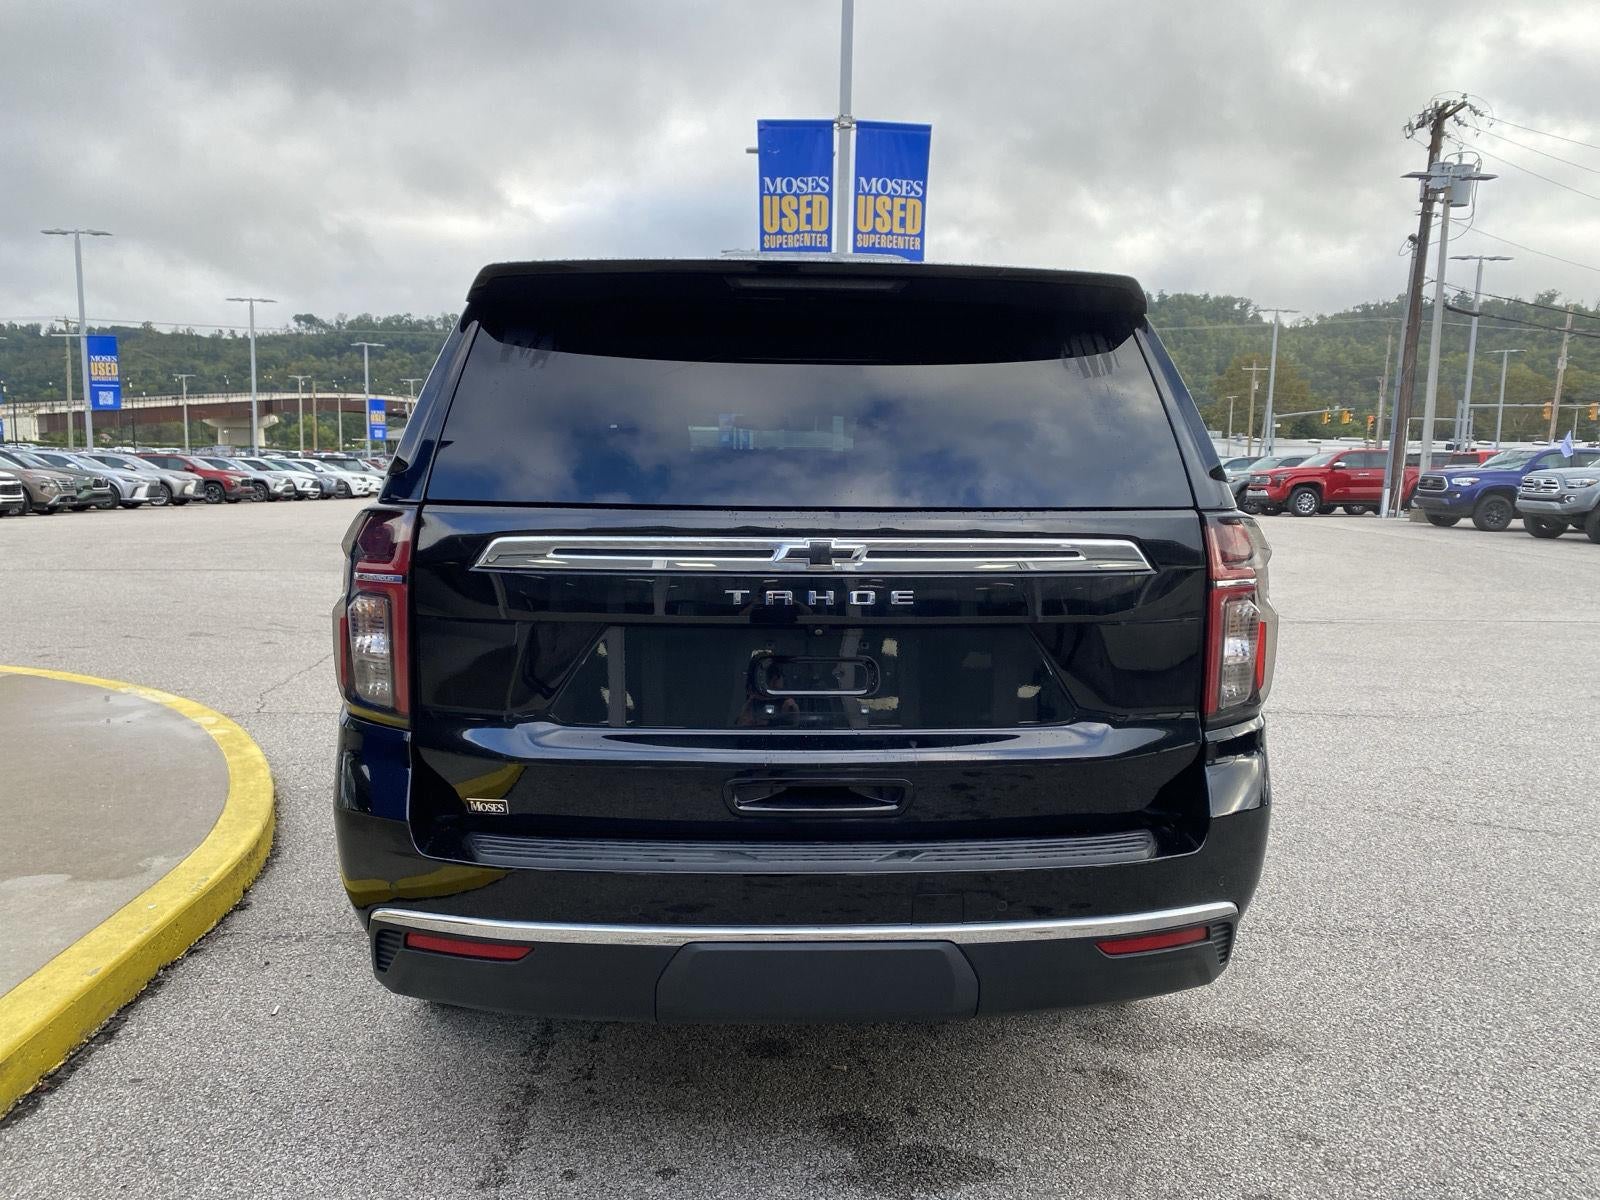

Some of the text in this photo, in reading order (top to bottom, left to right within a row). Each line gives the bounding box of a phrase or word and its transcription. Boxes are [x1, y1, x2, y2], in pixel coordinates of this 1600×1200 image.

[763, 176, 830, 194] MOSES
[858, 177, 924, 197] MOSES
[763, 195, 830, 233] USED
[857, 195, 923, 235] USED
[764, 233, 829, 248] SUPERCENTER
[856, 234, 921, 250] SUPERCENTER
[90, 362, 118, 376] USED
[724, 590, 915, 606] TAHOE
[470, 801, 505, 813] MOSES
